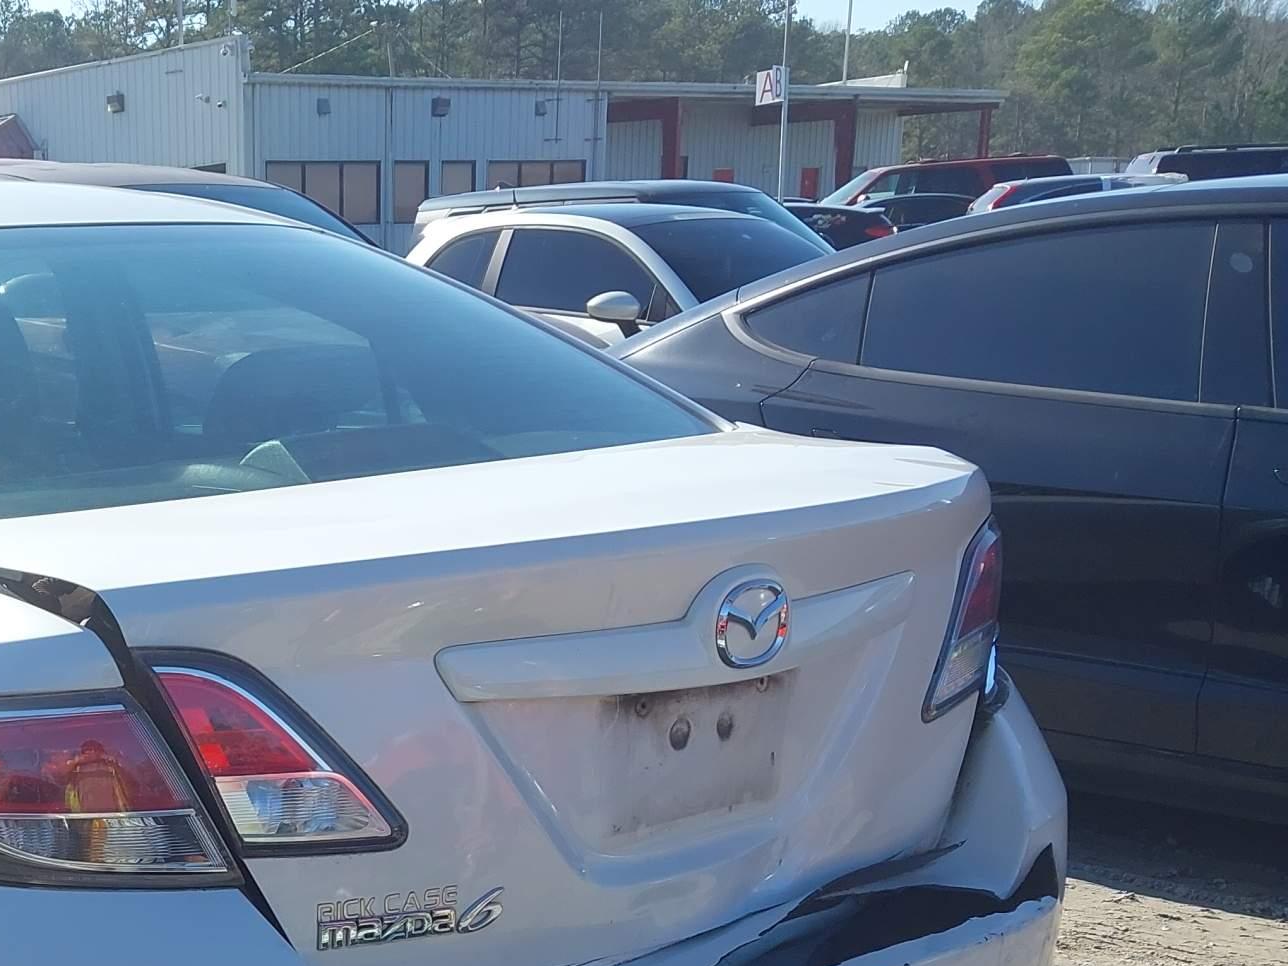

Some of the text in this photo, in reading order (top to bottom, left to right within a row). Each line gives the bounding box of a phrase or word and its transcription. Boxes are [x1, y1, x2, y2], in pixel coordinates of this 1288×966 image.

[759, 71, 775, 103] A
[316, 883, 458, 923] RICK CASE
